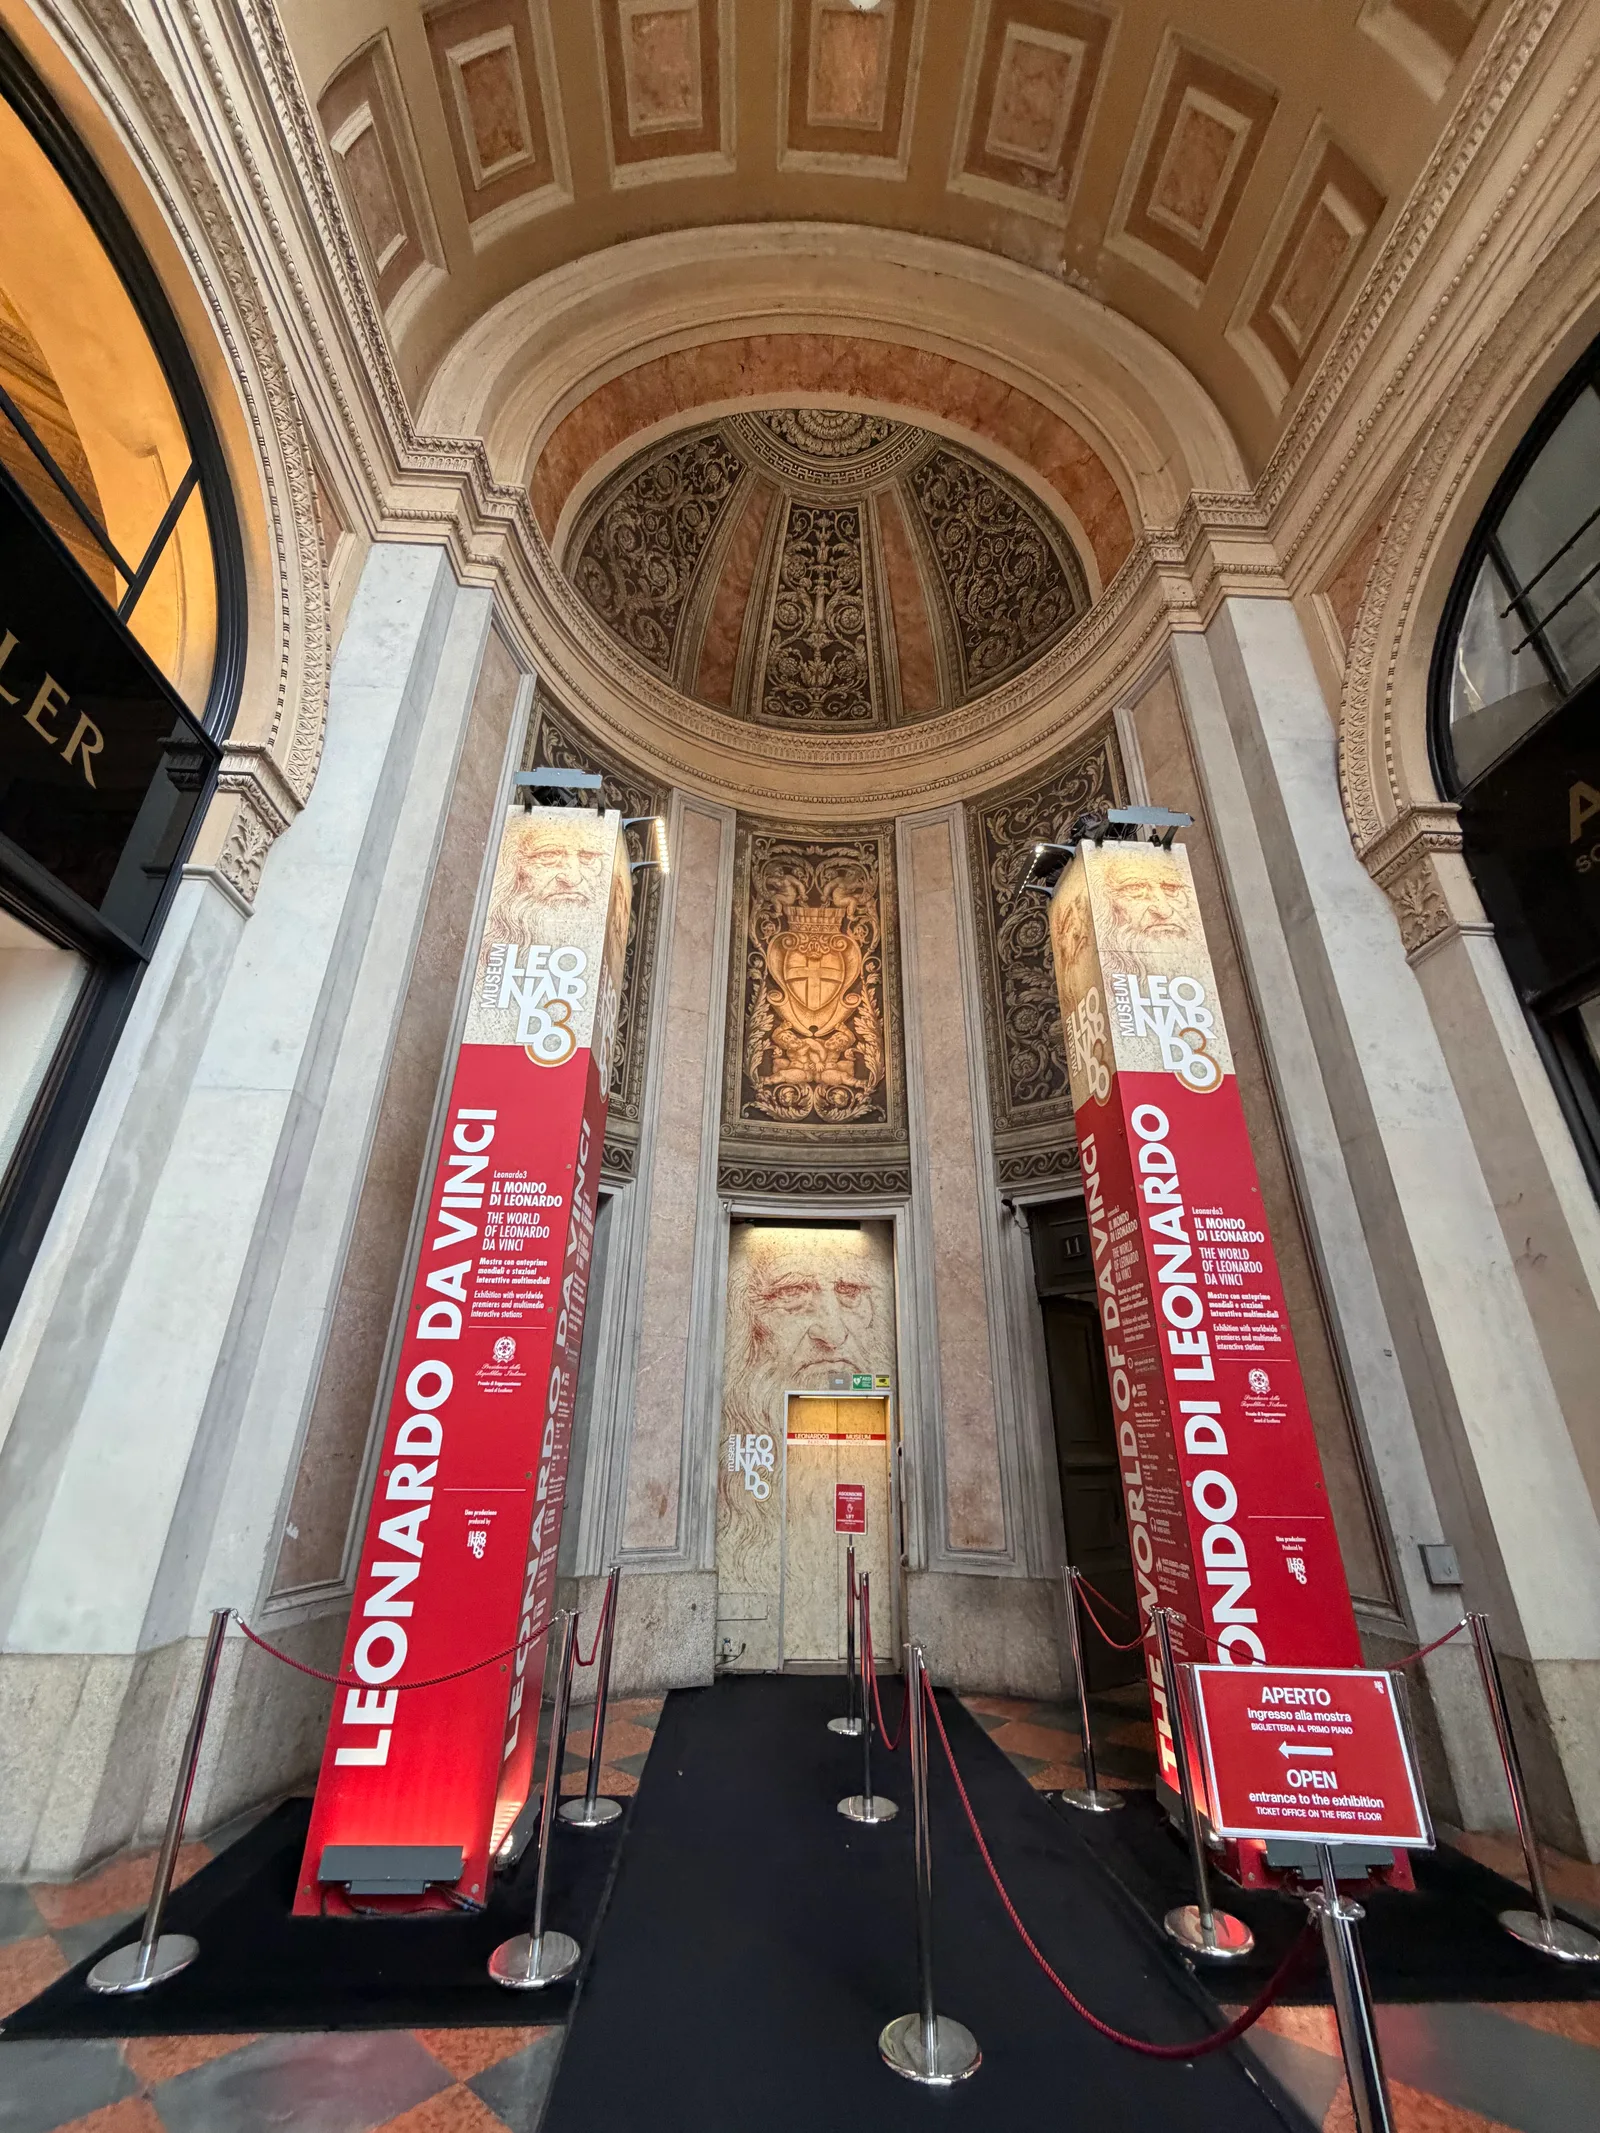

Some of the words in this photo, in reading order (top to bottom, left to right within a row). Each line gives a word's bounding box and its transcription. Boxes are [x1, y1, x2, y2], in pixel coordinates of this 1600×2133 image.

[0, 628, 105, 790] LER
[507, 944, 587, 977] LEO
[481, 943, 506, 1009] MUSEUM
[497, 976, 586, 1011] NAR
[1127, 974, 1205, 1006] LEO
[1111, 973, 1136, 1037] MUSEUM
[515, 1000, 571, 1060] DO
[1134, 1004, 1218, 1040] NAR
[1159, 1032, 1217, 1087] DO
[432, 1108, 498, 1251] VINCI
[492, 1182, 500, 1193] IL
[504, 1182, 547, 1194] MONDO
[494, 1171, 527, 1179] Leonardo3
[490, 1195, 501, 1205] DI
[504, 1195, 562, 1207] LEONARDO
[1081, 1132, 1109, 1261] VINCI
[487, 1212, 504, 1224] THE
[507, 1213, 539, 1225] WORLD
[1192, 1207, 1223, 1215] Leonardo3
[1194, 1218, 1204, 1228] IL
[1206, 1218, 1245, 1230] MONDO
[485, 1225, 498, 1237] OF
[500, 1226, 549, 1238] LEONARDO
[1131, 1104, 1216, 1382] LEONARDO
[1196, 1230, 1208, 1241] DI
[1210, 1230, 1264, 1243] LEONARDO
[482, 1239, 495, 1250] DA
[499, 1239, 523, 1251] VINCI
[1199, 1247, 1216, 1259] THE
[1217, 1248, 1249, 1260] WORLD
[1202, 1260, 1214, 1272] OF
[1216, 1260, 1263, 1273] LEONARDO
[1204, 1273, 1218, 1285] DA
[1219, 1274, 1243, 1286] VINCI
[416, 1259, 472, 1340] DA
[1099, 1259, 1120, 1331] DA
[1107, 1345, 1131, 1413] OF
[504, 1365, 561, 1762] LEONARDO
[556, 1271, 574, 1348] DA
[567, 1118, 591, 1258] VINCI
[1179, 1400, 1229, 1455] DI
[735, 1433, 773, 1454] LEO
[334, 1358, 454, 1766] LEONARDO
[1192, 1469, 1266, 1666] ONDO
[1261, 1686, 1331, 1706] APERTO
[1294, 1709, 1312, 1721] alla
[1314, 1712, 1352, 1722] mostra
[1251, 1723, 1296, 1733] BIGLIETTERIA
[1297, 1724, 1307, 1733] AL
[1308, 1724, 1330, 1734] PRIMO
[1331, 1726, 1353, 1735] PIANO
[1286, 1769, 1338, 1789] OPEN
[1249, 1792, 1297, 1804] entrance
[1298, 1794, 1310, 1805] to
[1312, 1794, 1330, 1806] the
[1332, 1794, 1384, 1808] exhibition
[1256, 1807, 1280, 1816] TICKET
[1282, 1808, 1306, 1817] OFFICE
[1308, 1809, 1320, 1818] ON
[1321, 1810, 1336, 1819] THE
[1336, 1810, 1356, 1820] FIRST
[1357, 1811, 1382, 1821] FLOOR
